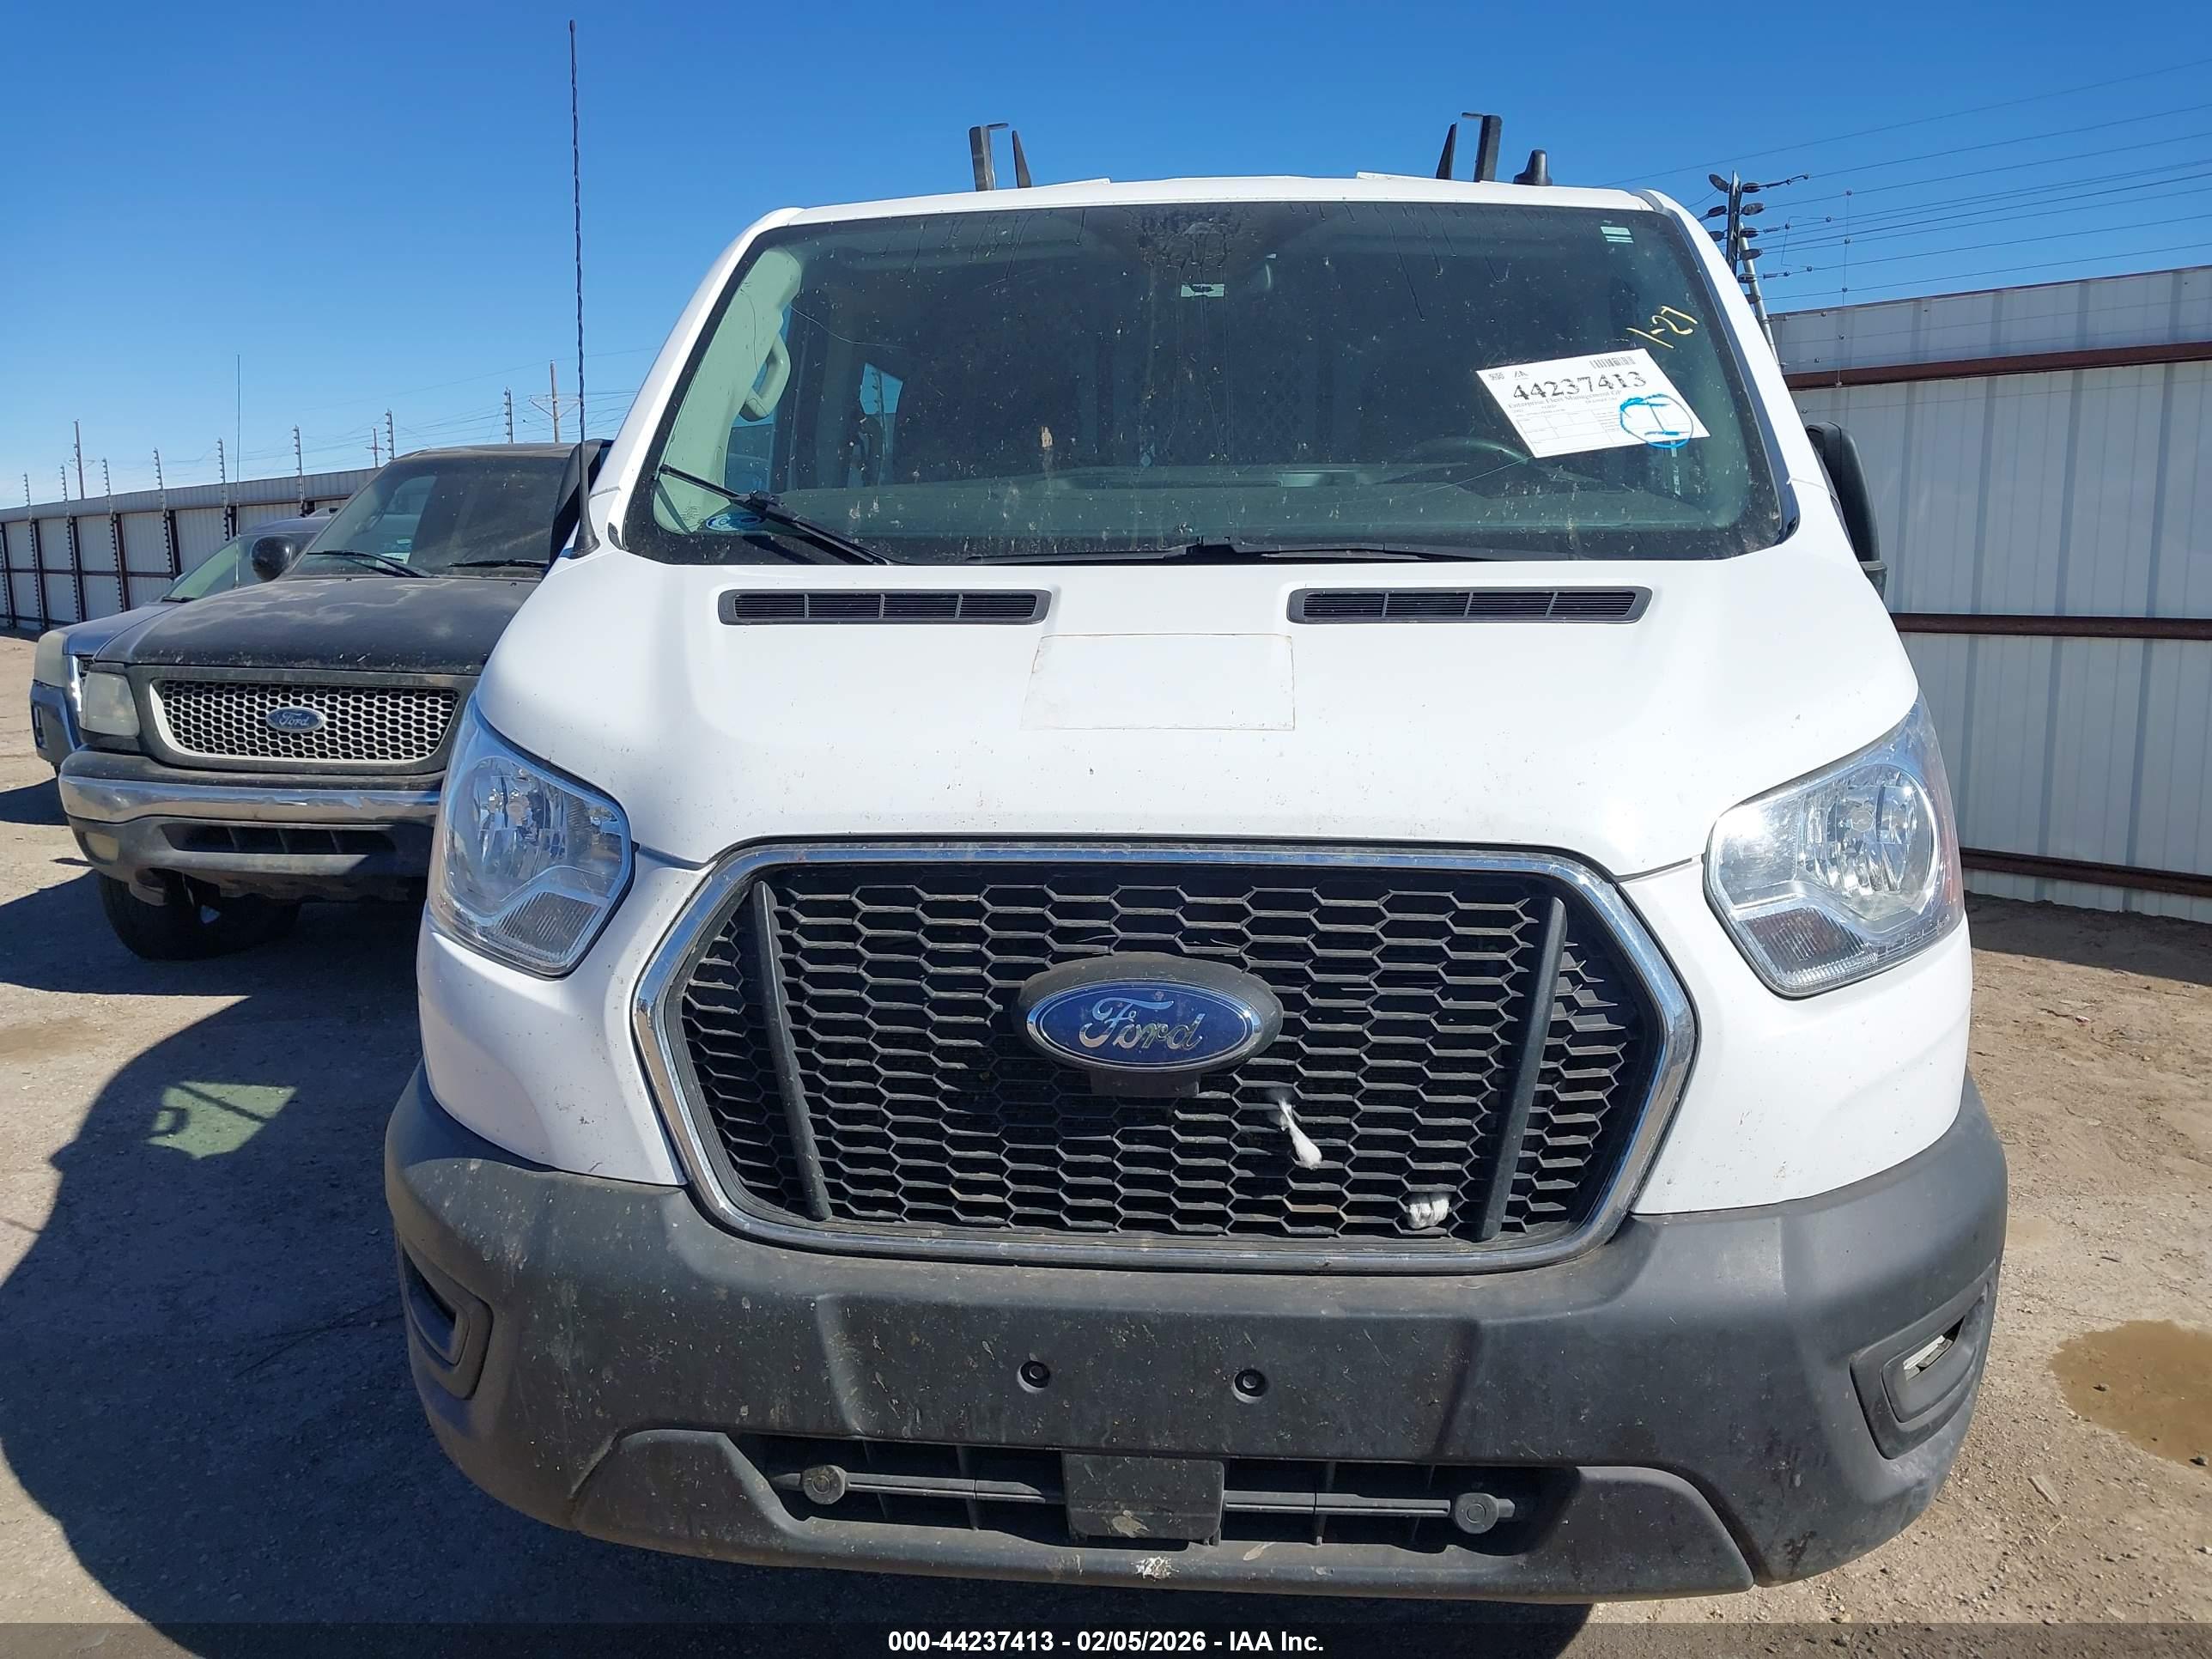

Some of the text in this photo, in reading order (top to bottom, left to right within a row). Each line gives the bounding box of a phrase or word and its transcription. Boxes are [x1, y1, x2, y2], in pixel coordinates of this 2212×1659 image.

[1513, 371, 1648, 400] 44237413
[279, 711, 310, 726] Ford
[1079, 996, 1206, 1050] Ford
